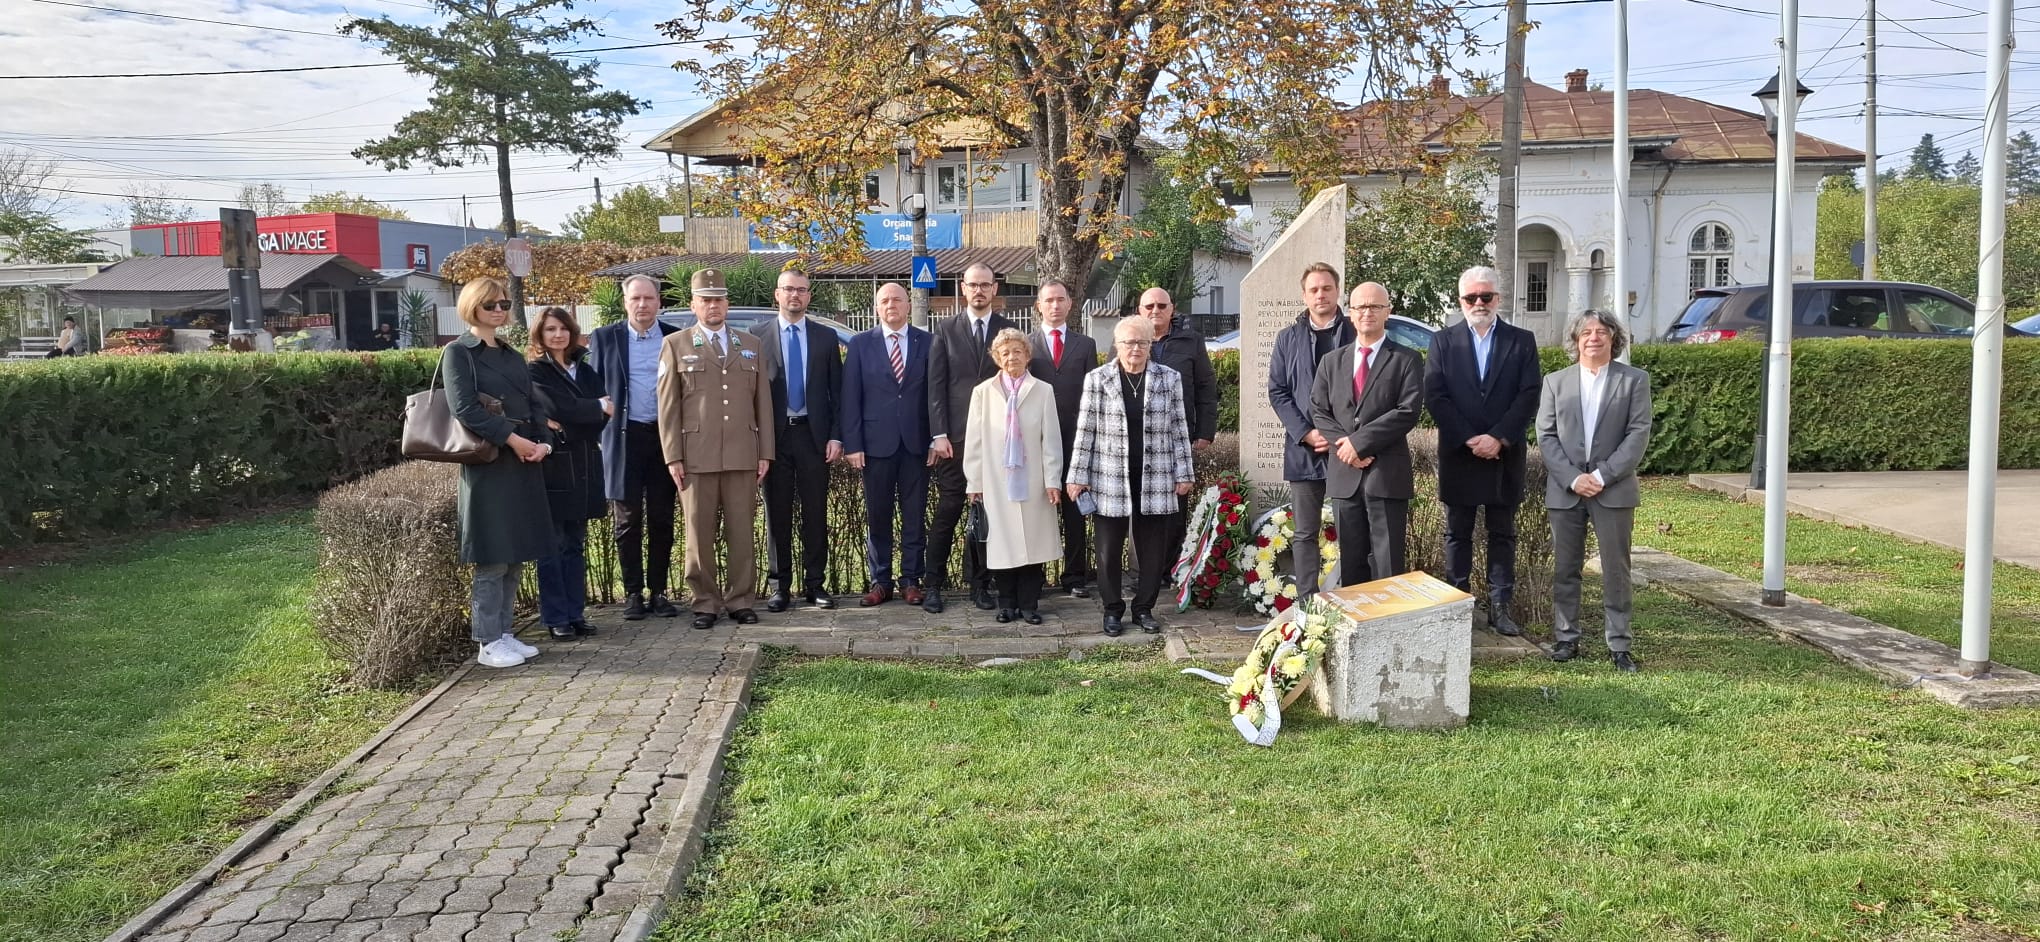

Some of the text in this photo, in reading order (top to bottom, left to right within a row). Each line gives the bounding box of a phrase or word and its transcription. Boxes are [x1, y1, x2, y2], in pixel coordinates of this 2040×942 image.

[257, 230, 327, 251] GA IMAGE
[507, 250, 530, 265] STOP
